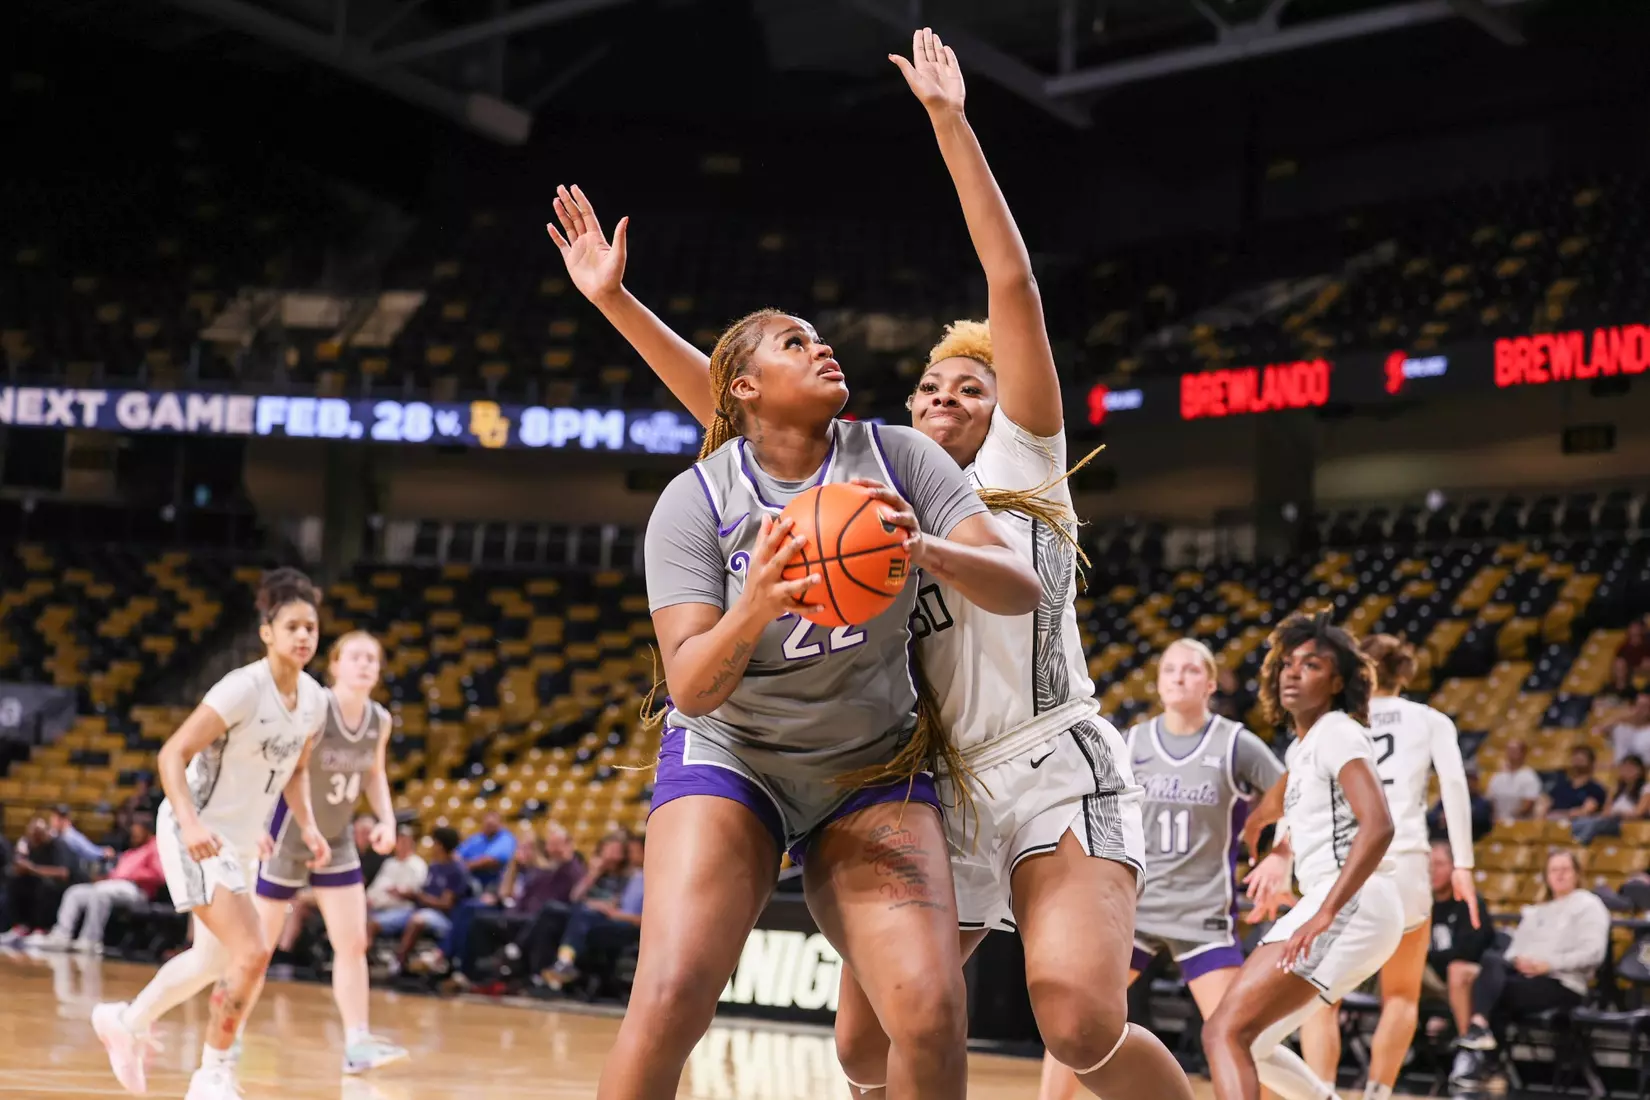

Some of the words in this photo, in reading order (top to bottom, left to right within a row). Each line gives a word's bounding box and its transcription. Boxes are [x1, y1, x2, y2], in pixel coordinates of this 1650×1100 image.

[1493, 324, 1650, 387] BREWLAND
[115, 390, 255, 433] GAME
[371, 400, 434, 442] 28
[518, 405, 625, 450] 8PM
[776, 611, 868, 661] 22
[1157, 809, 1189, 855] 11
